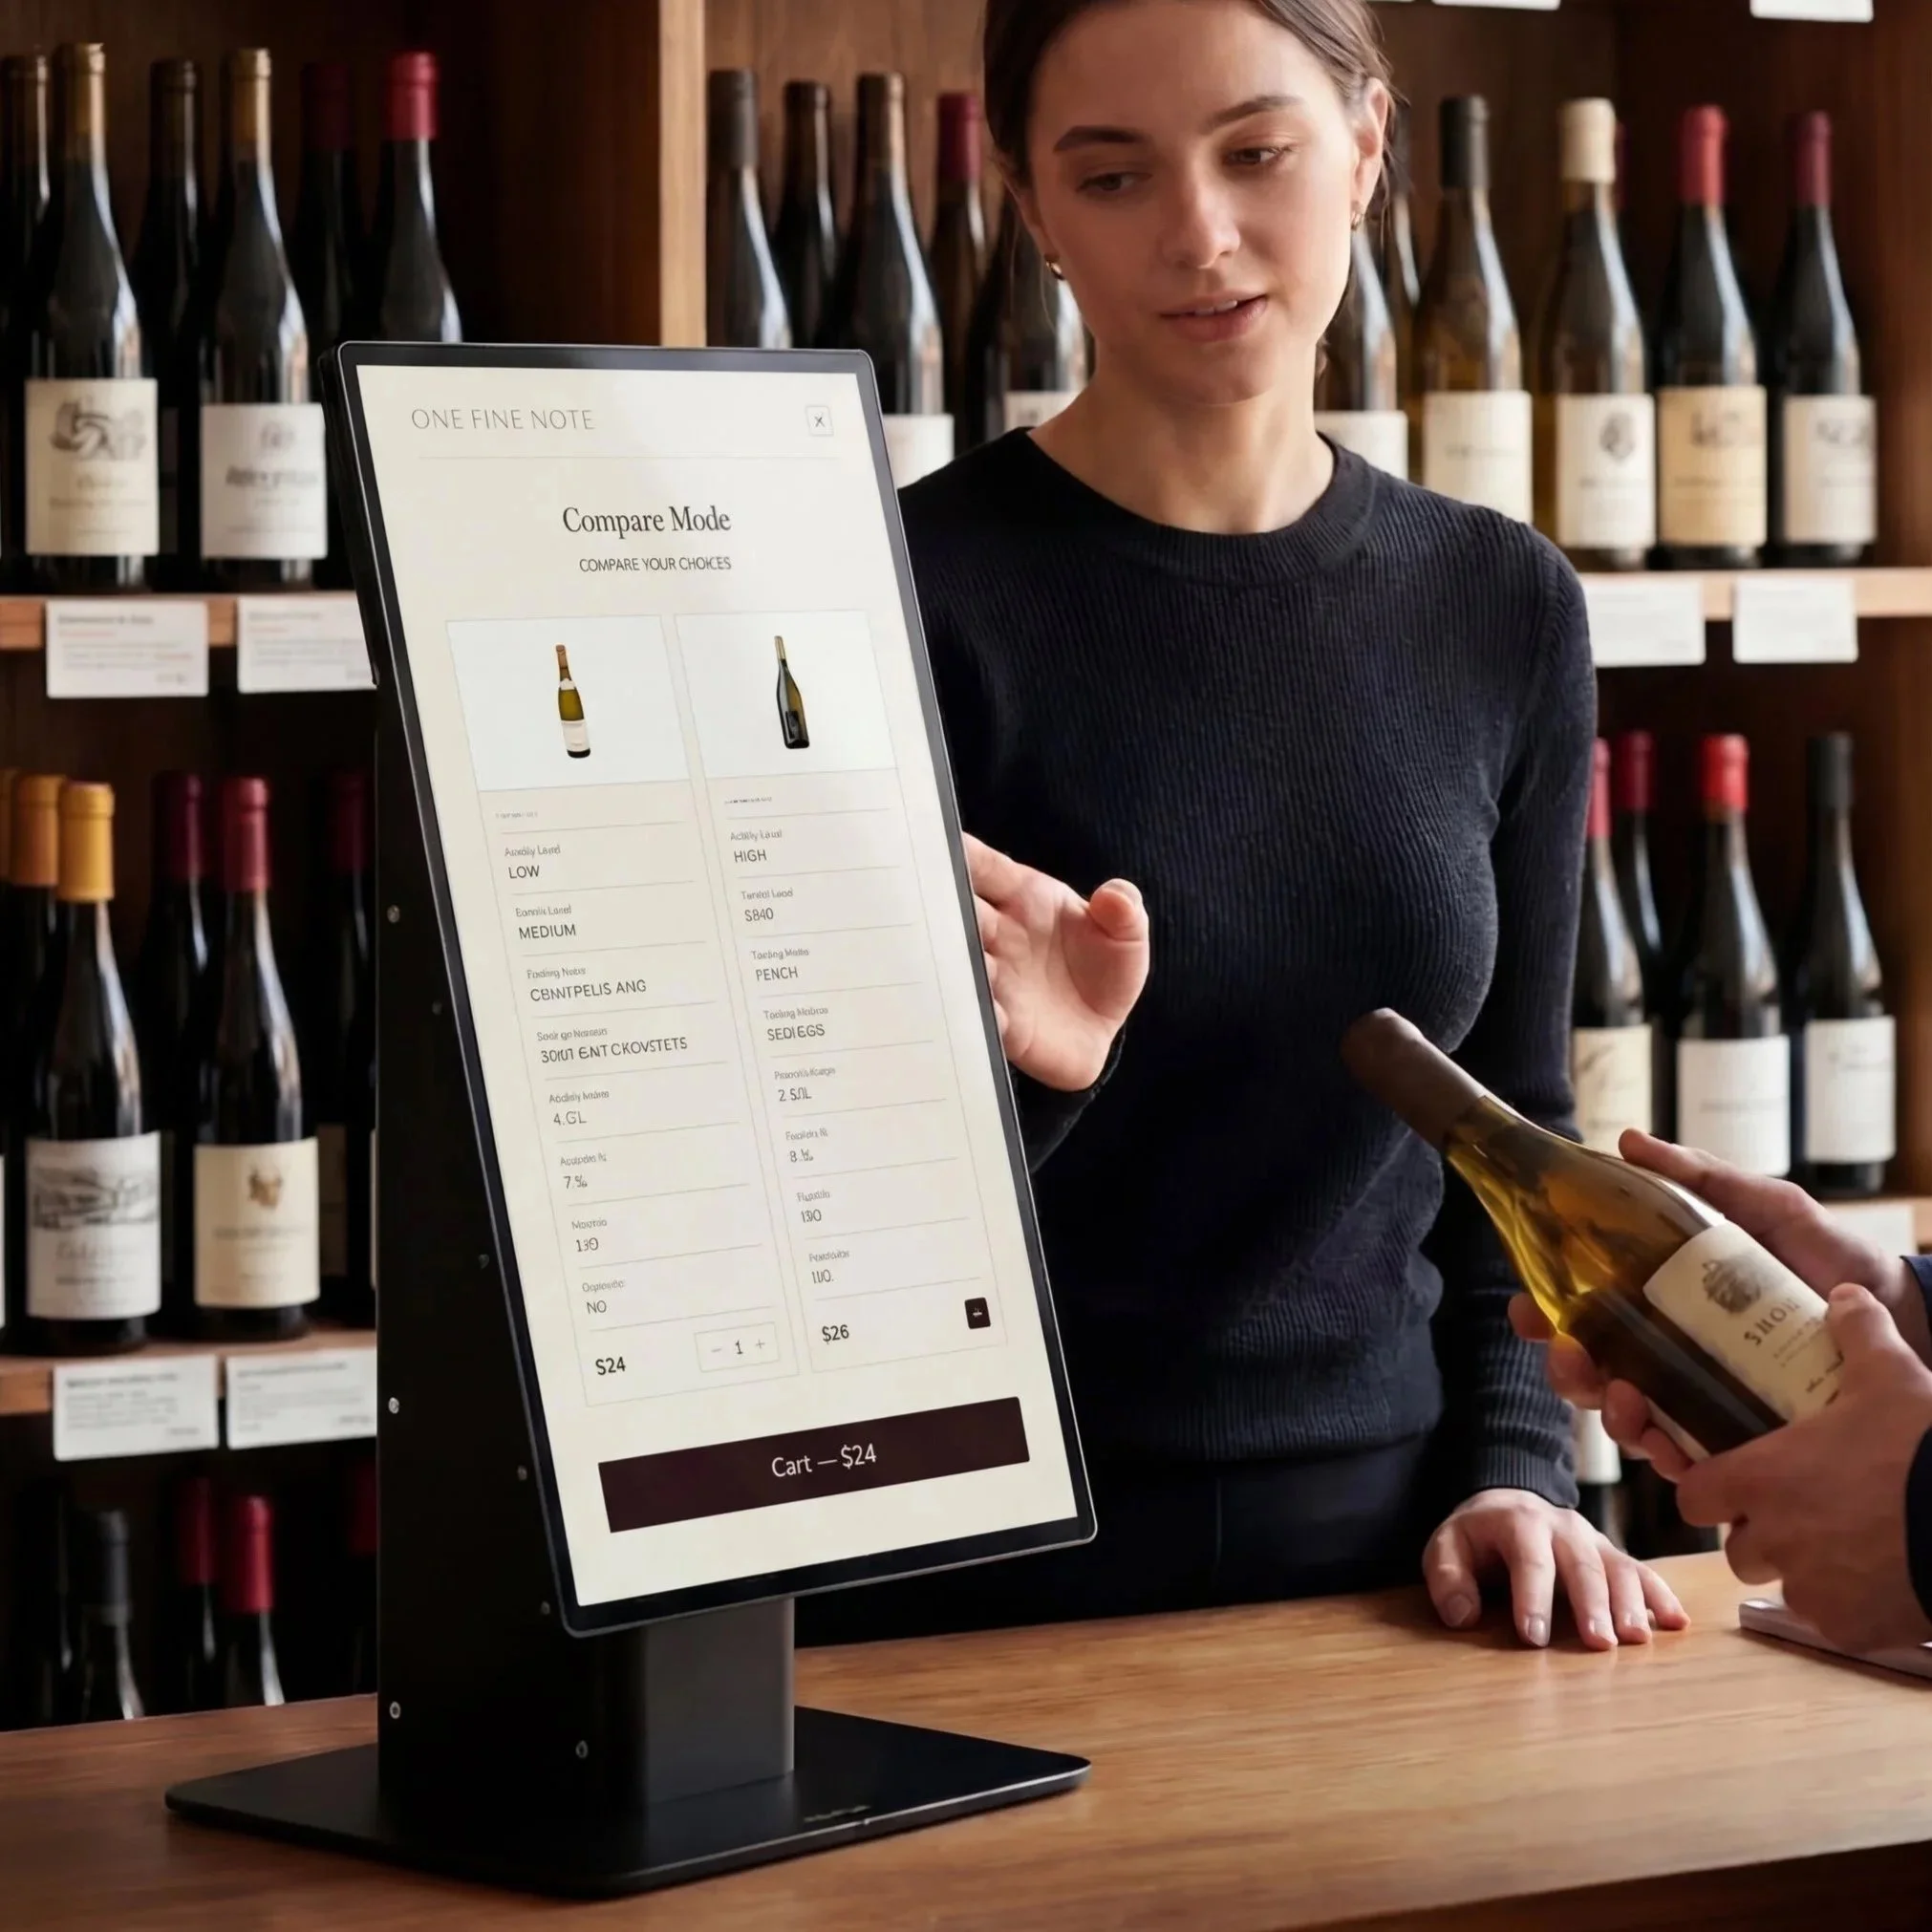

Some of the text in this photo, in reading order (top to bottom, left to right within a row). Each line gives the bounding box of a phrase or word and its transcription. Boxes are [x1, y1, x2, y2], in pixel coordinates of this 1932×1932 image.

[411, 408, 593, 430] ONE FINE NOTE
[562, 504, 732, 540] Compare Mode
[579, 557, 640, 573] COMPARE
[641, 557, 677, 571] YOUR
[733, 848, 767, 863] HIGH
[507, 865, 540, 880] LOW
[518, 923, 576, 940] MEDIUM
[755, 966, 799, 981] PENCH
[615, 978, 647, 995] ANG
[586, 1299, 608, 1315] NO
[821, 1323, 850, 1345] $26
[735, 1340, 743, 1355] 1
[771, 1455, 813, 1477] Cart
[840, 1443, 877, 1470] $24
